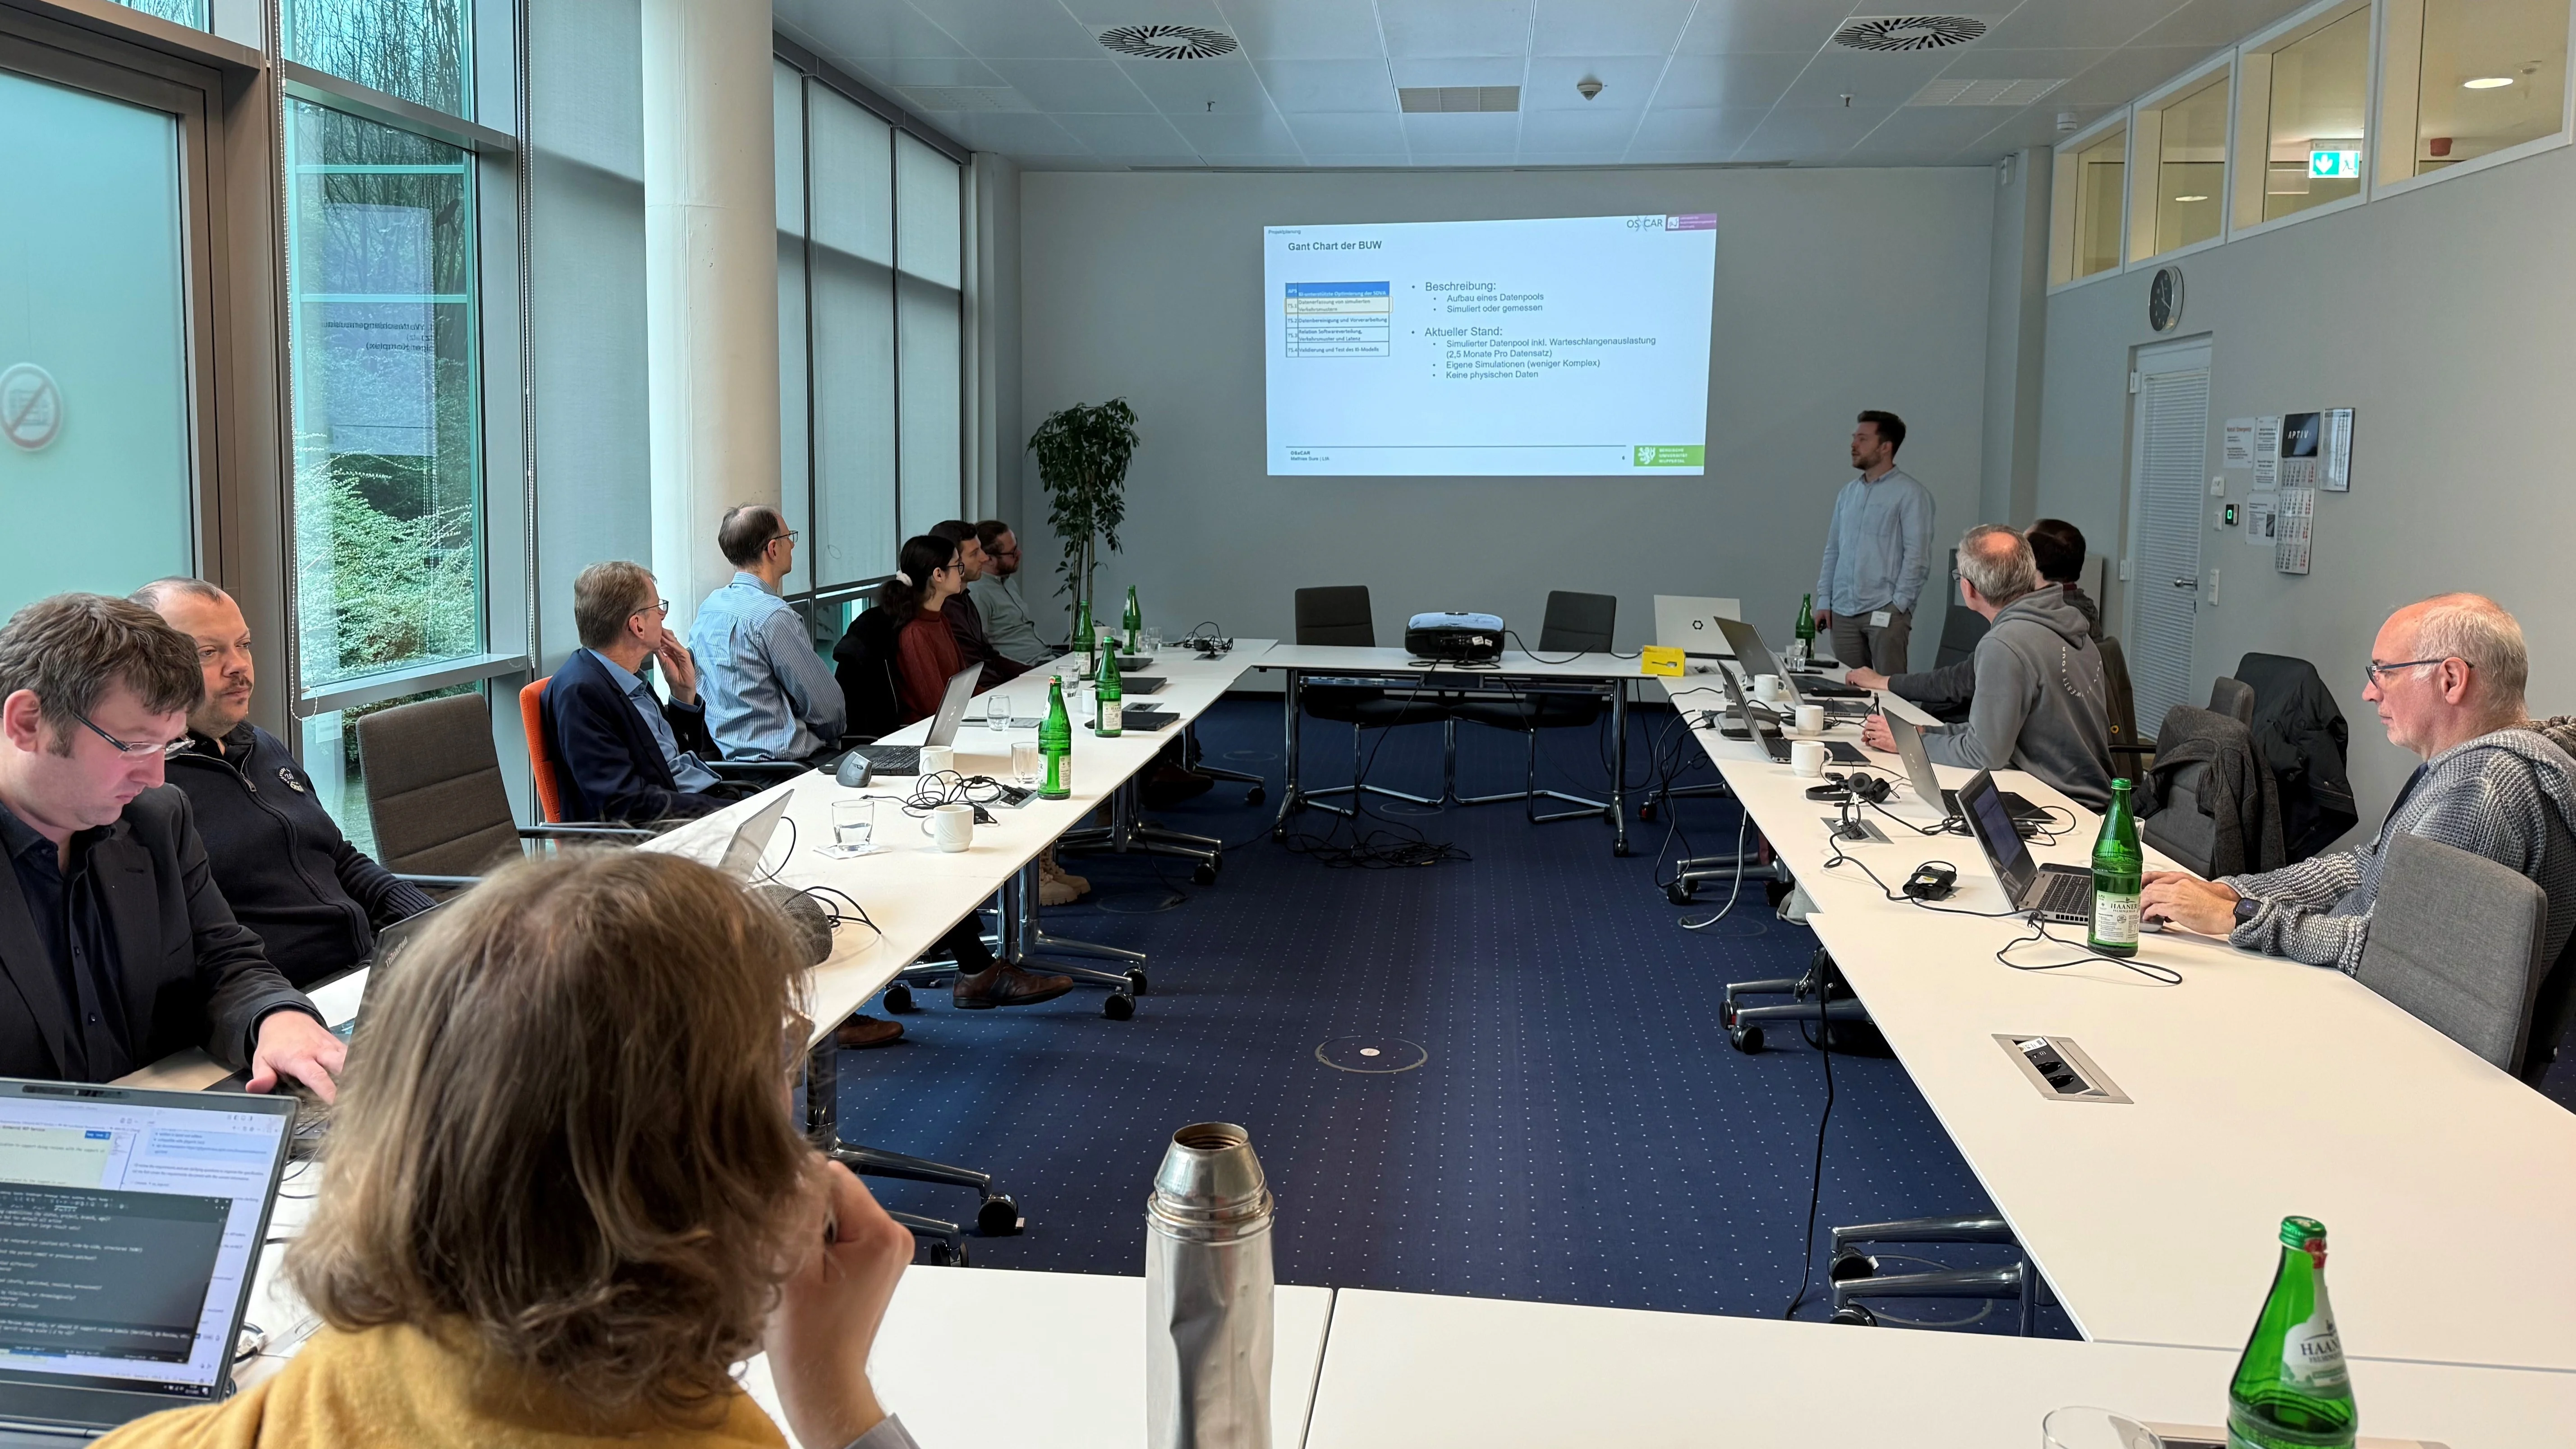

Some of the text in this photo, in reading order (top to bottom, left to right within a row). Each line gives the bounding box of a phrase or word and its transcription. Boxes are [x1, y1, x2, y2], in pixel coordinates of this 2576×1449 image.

[1288, 241, 1382, 251] Gant Chart der BUW
[1425, 281, 1496, 292] Beschreibung:
[1500, 293, 1544, 302] Datenpools
[1502, 304, 1543, 313] gemessen
[1425, 327, 1503, 337] Aktueller Stand:
[1490, 339, 1529, 348] Datenpool
[1531, 338, 1547, 346] inkl.
[1549, 337, 1656, 346] Warteschlangenauslastung
[1446, 350, 1462, 359] (2,5
[1510, 349, 1552, 358] Datensatz)
[1446, 359, 1601, 370] Eigene Simulationen (weniger Komplex)
[1470, 370, 1513, 380] physischen
[1515, 370, 1539, 378] Daten
[2287, 429, 2309, 439] APTIV
